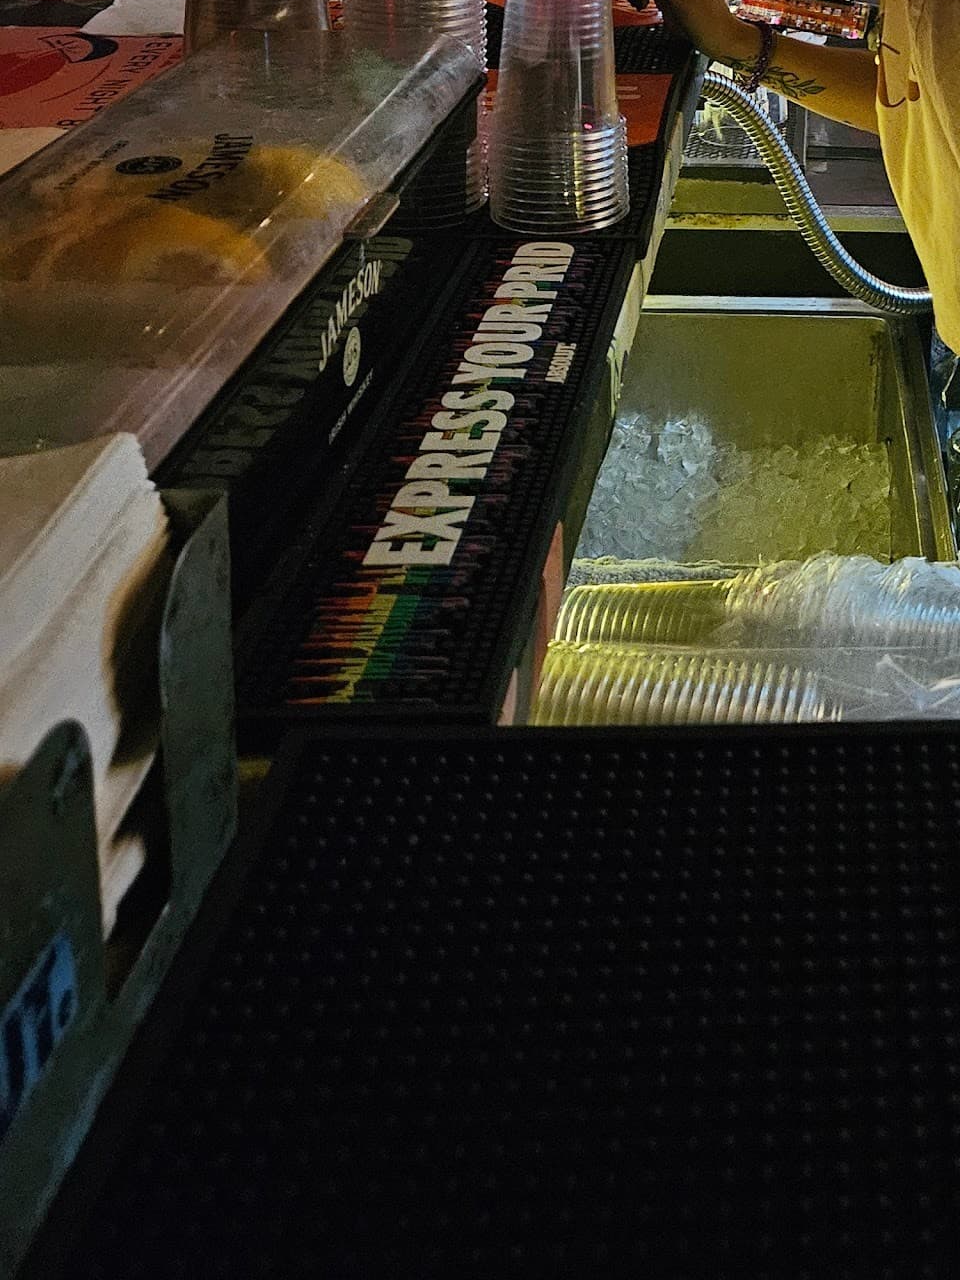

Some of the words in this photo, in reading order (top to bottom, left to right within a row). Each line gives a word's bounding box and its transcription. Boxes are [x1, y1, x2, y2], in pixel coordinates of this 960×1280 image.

[119, 41, 173, 74] EVERY
[74, 78, 131, 112] NIGHT
[147, 132, 254, 201] JAMESON
[317, 259, 384, 372] JAMESON
[362, 391, 517, 568] EXPRESS
[451, 305, 554, 386] YOUR
